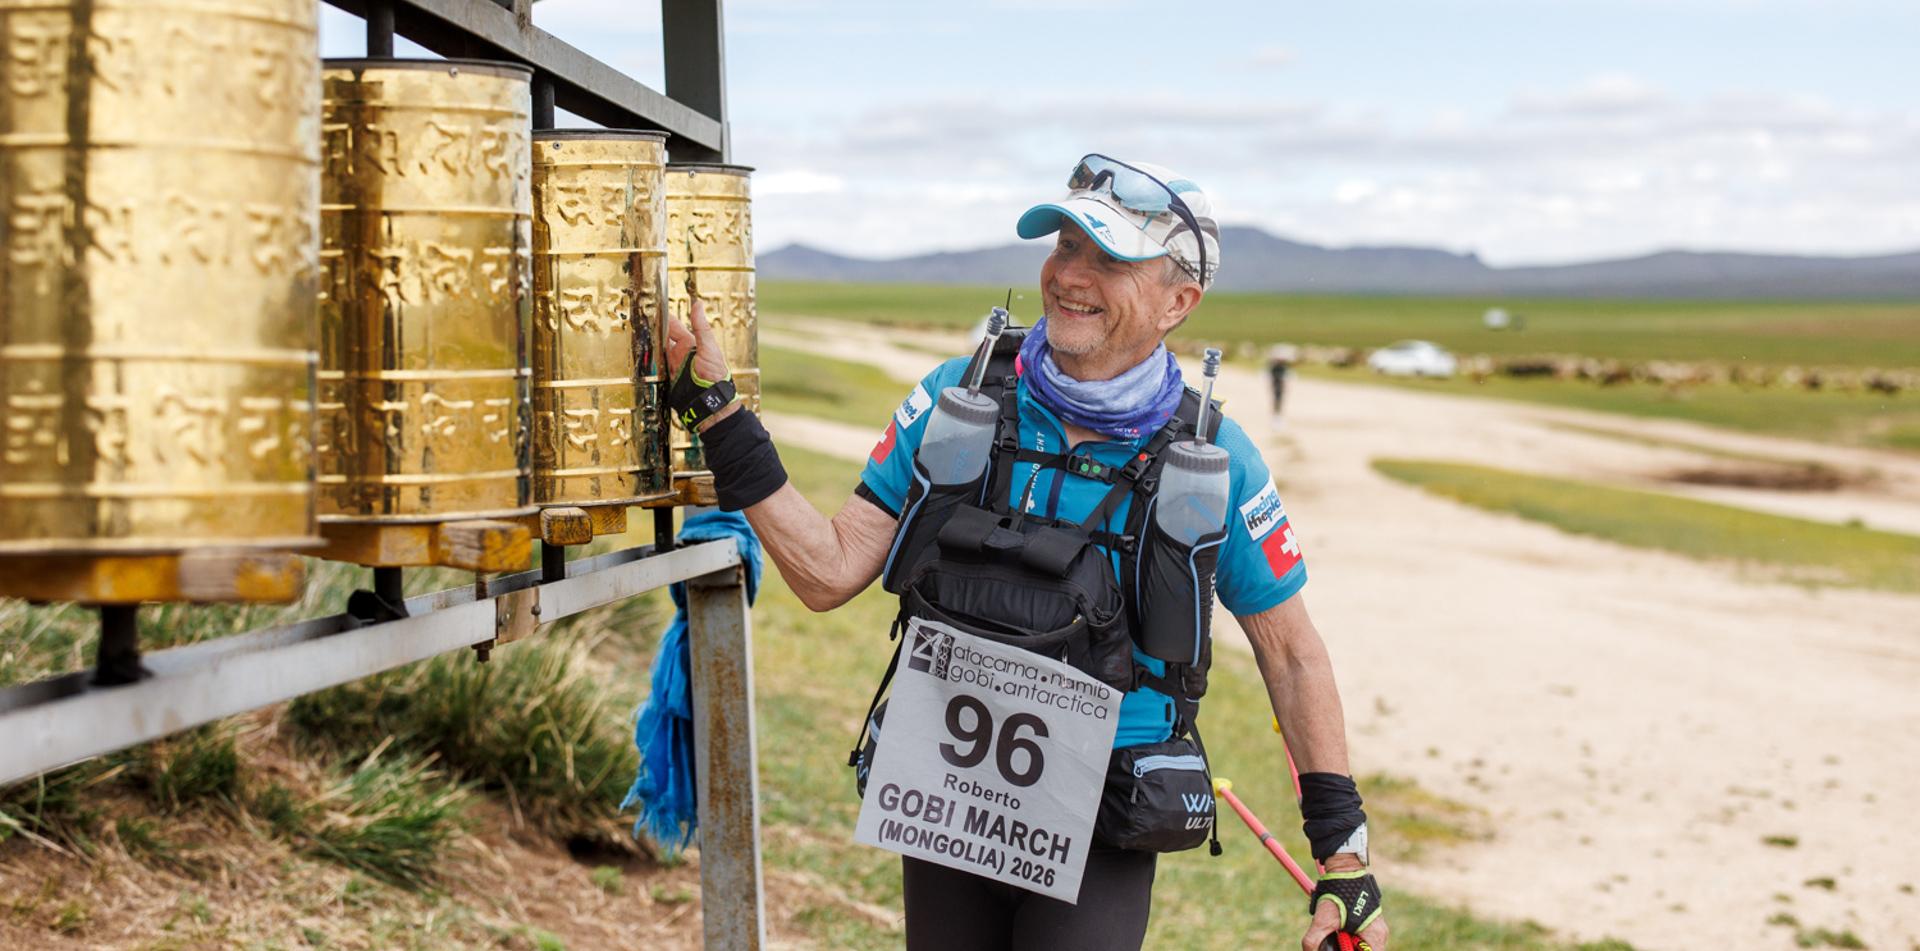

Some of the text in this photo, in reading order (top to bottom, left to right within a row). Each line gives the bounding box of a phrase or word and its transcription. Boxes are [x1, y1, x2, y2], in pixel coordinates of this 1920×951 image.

[939, 694, 1049, 787] 96
[878, 783, 1071, 864] GOBI MARCH
[943, 773, 1021, 810] Roberto
[878, 818, 1055, 887] (MONGOLIA) 2026
[1353, 891, 1369, 916] LEKI
